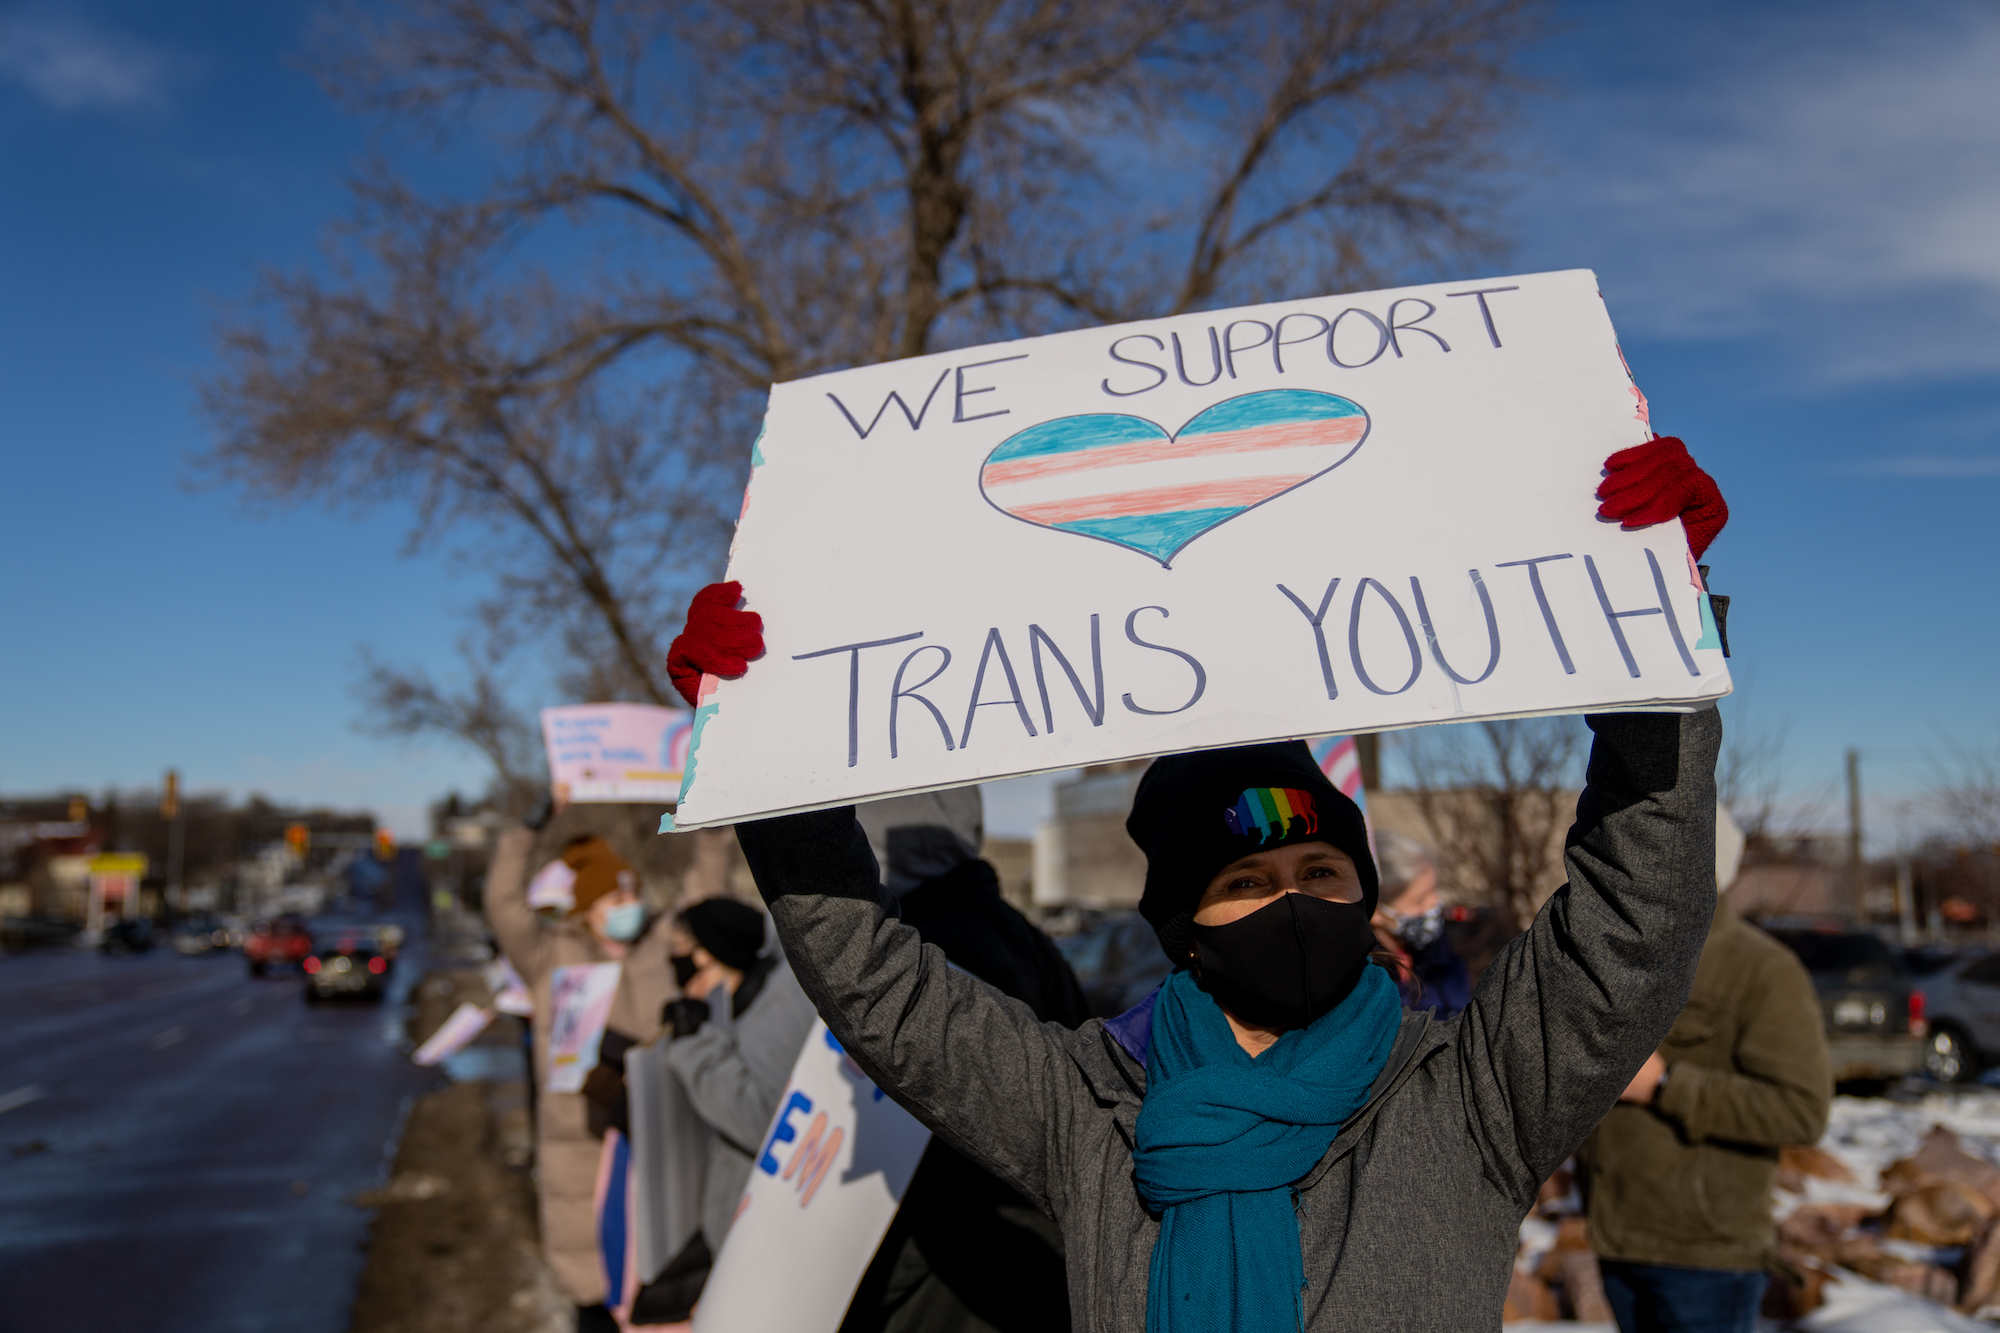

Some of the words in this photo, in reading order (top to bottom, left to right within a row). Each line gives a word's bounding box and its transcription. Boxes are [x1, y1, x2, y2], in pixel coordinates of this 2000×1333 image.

[825, 353, 1030, 440] WE
[1100, 285, 1521, 398] SUPPORT
[790, 604, 1208, 768] TRANS
[1275, 546, 1704, 702] YOUTH
[757, 1087, 846, 1210] EM
